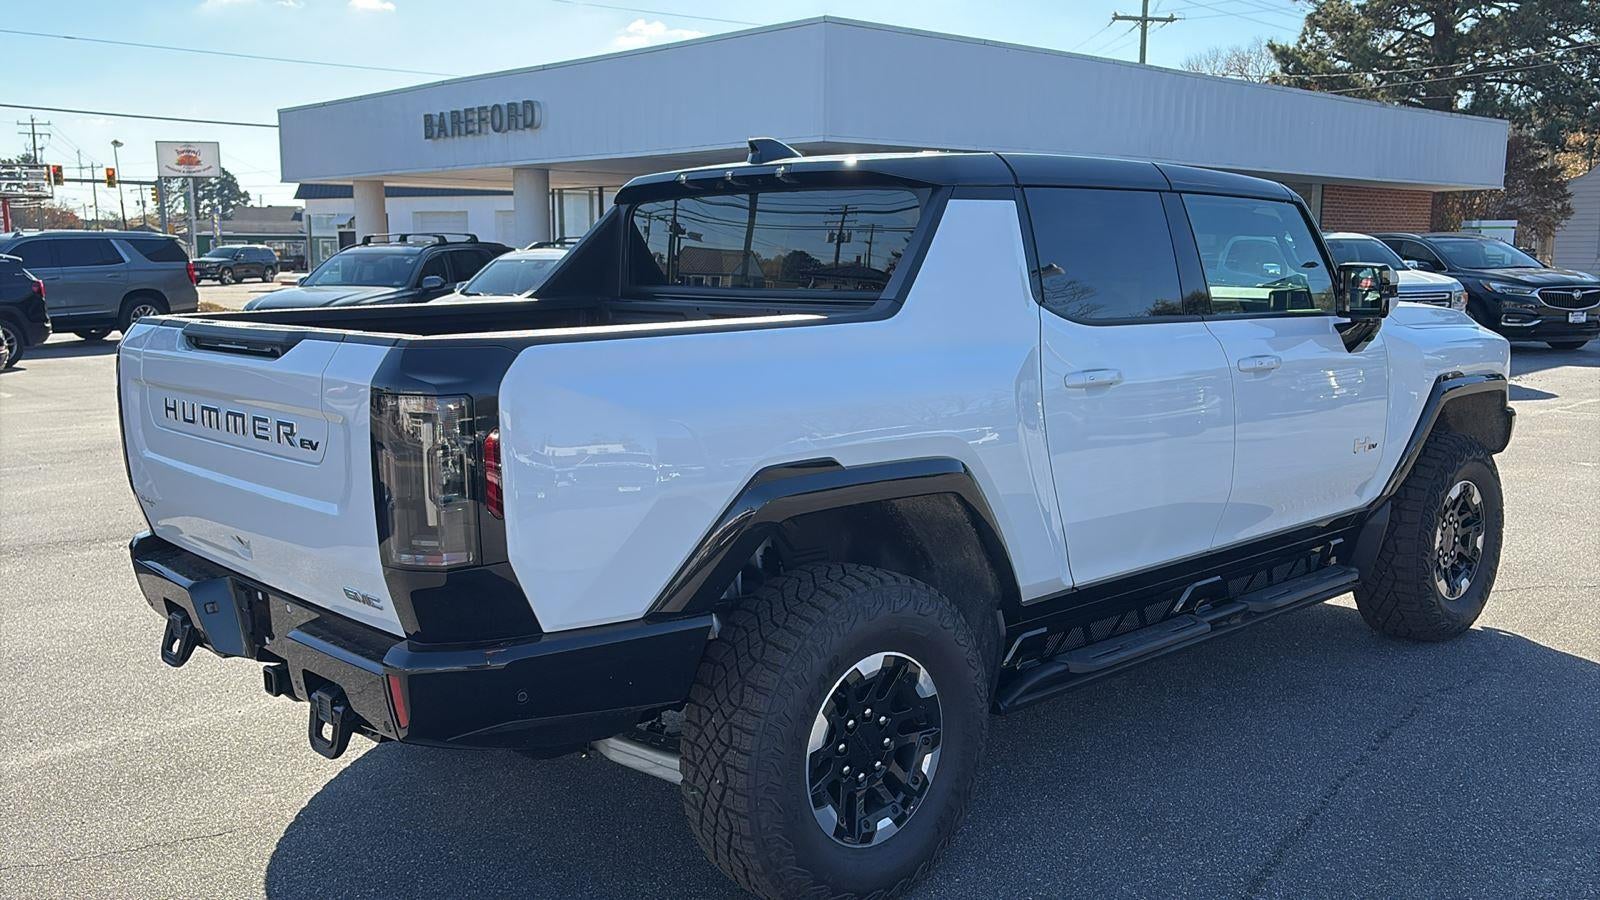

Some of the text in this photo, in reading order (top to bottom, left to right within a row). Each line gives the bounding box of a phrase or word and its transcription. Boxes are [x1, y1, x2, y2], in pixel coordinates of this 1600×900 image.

[424, 100, 542, 140] BAREFORD
[163, 397, 319, 452] HUMMER EV
